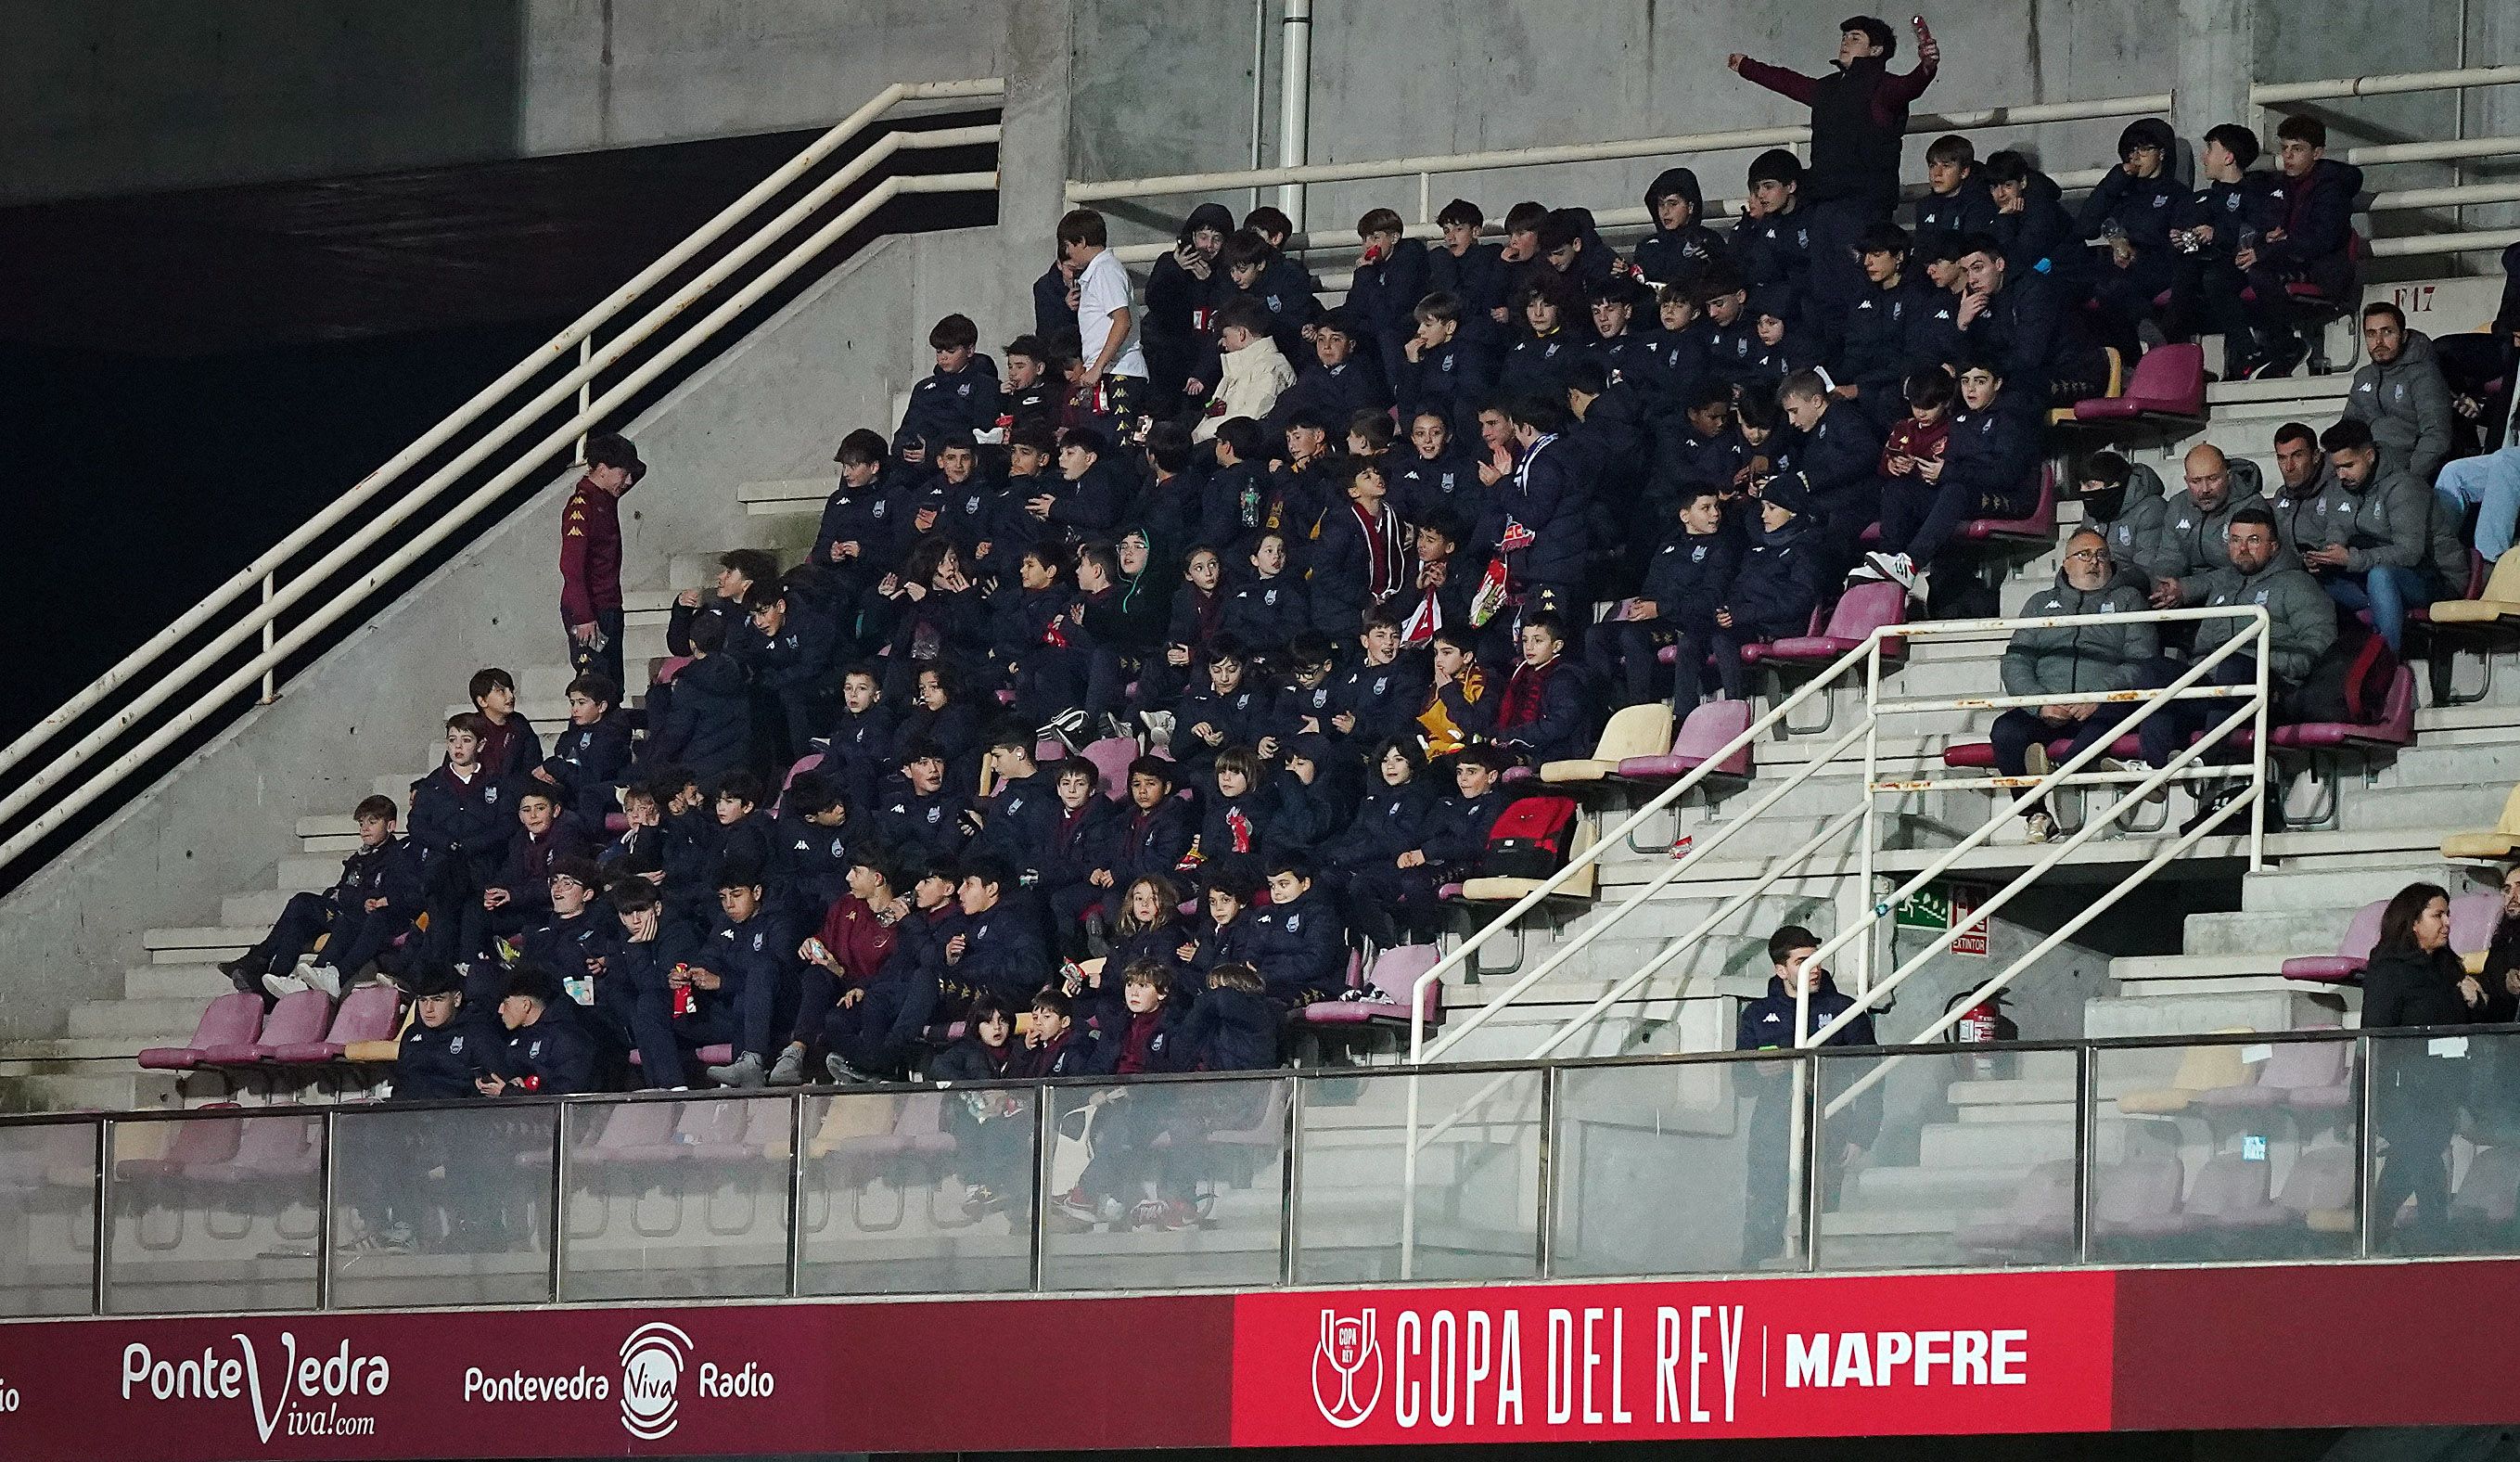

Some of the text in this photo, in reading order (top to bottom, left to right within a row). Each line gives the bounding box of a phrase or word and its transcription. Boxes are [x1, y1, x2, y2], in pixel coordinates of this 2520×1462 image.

[1338, 1327, 1357, 1346] COPA
[1395, 1304, 1744, 1429] COPA DEL REY
[1784, 1328, 2028, 1389] MAPFRE
[122, 1331, 390, 1444] PonteVedra
[464, 1361, 774, 1403] Pontevedra Viva Radio
